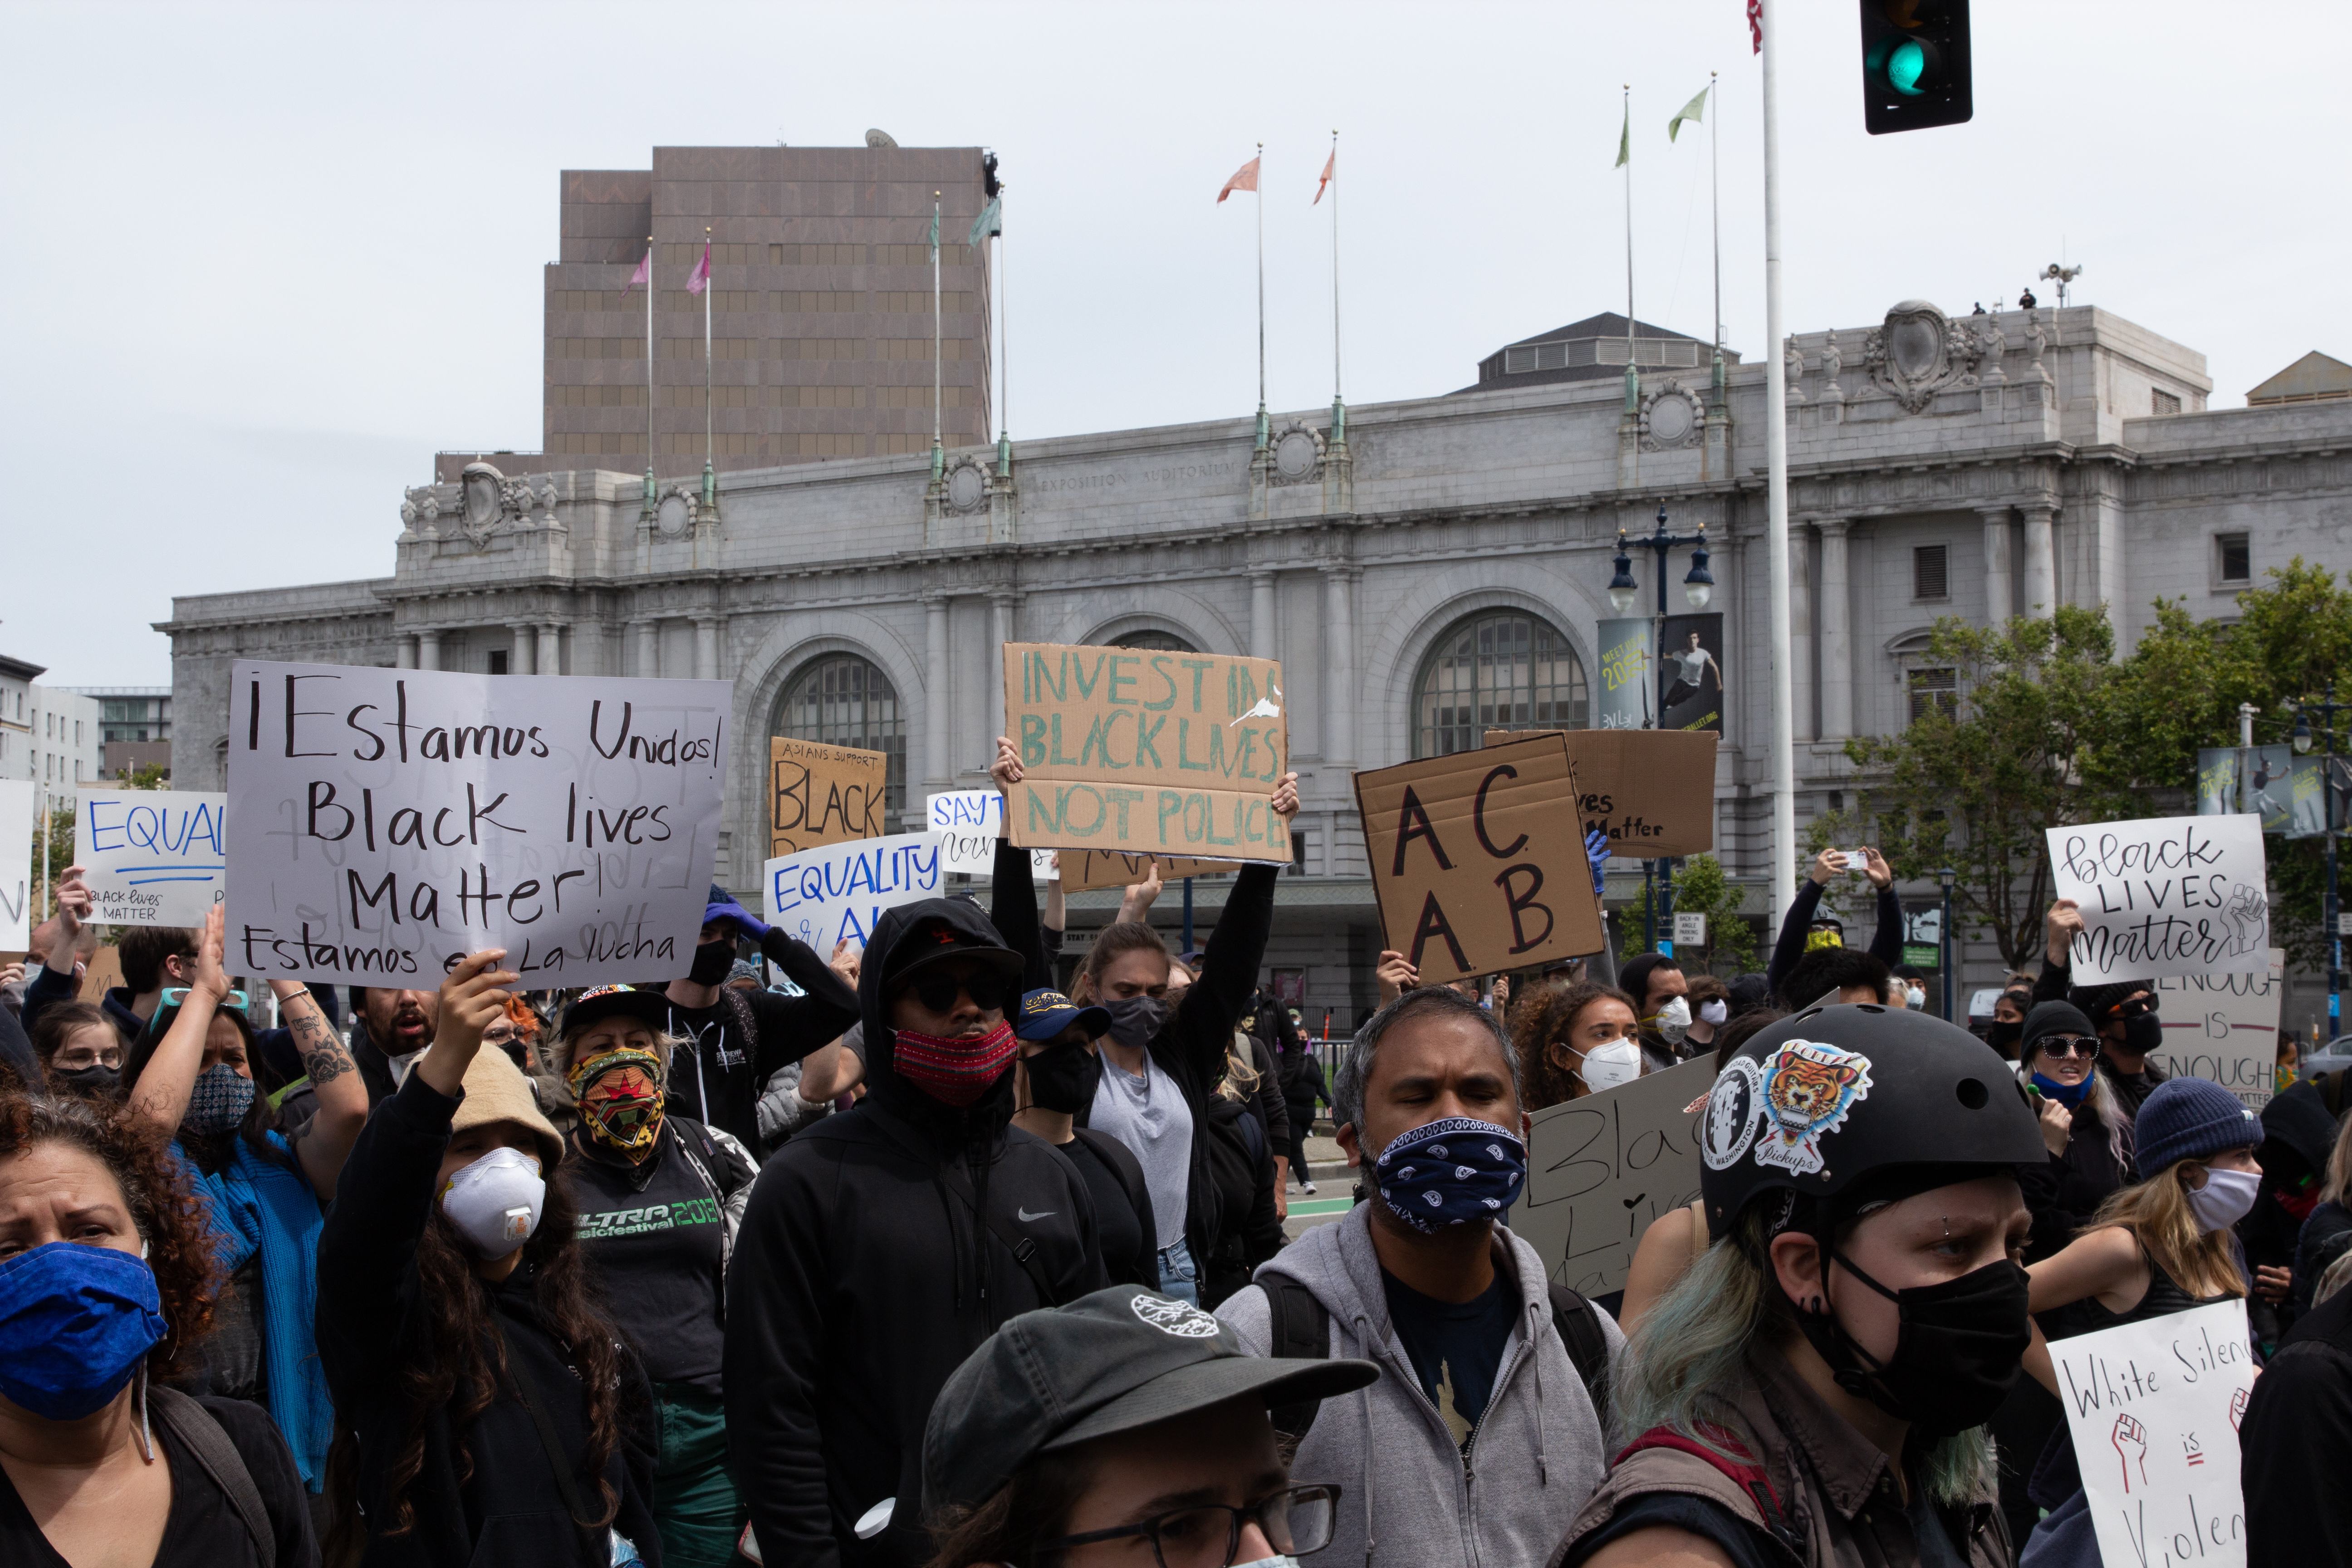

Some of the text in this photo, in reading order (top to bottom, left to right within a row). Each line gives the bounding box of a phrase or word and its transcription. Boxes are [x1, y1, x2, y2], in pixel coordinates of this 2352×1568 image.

[1042, 462, 1235, 492] EXPOSITION AUDITORIUM
[1602, 644, 1624, 664] MEET
[1022, 651, 1277, 718] INVEST IN
[783, 743, 878, 771] ASIANS SUPPORT
[1020, 709, 1279, 784] BLACK LIVES
[309, 780, 671, 852] Black lives
[774, 760, 884, 839] BLACK
[934, 794, 987, 826] SAY
[1026, 783, 1144, 841] NOT
[1157, 789, 1287, 848] POLICE
[2060, 825, 2224, 883] black
[774, 844, 939, 914] EQUALITY
[2097, 874, 2227, 914] LIVES
[91, 891, 125, 903] BLACK
[103, 906, 156, 921] MATTER
[240, 921, 418, 973] Estamos
[1066, 933, 1085, 941] STAY
[2205, 1012, 2228, 1039] IS
[1746, 1062, 1759, 1093] GUITARS
[2150, 1054, 2273, 1088] ENOUGH
[1715, 1120, 1755, 1166] WASHINGTON
[671, 1198, 719, 1225] 2013
[573, 1217, 674, 1240] sicfestival
[2062, 1353, 2160, 1419] White
[2180, 1431, 2200, 1453] is
